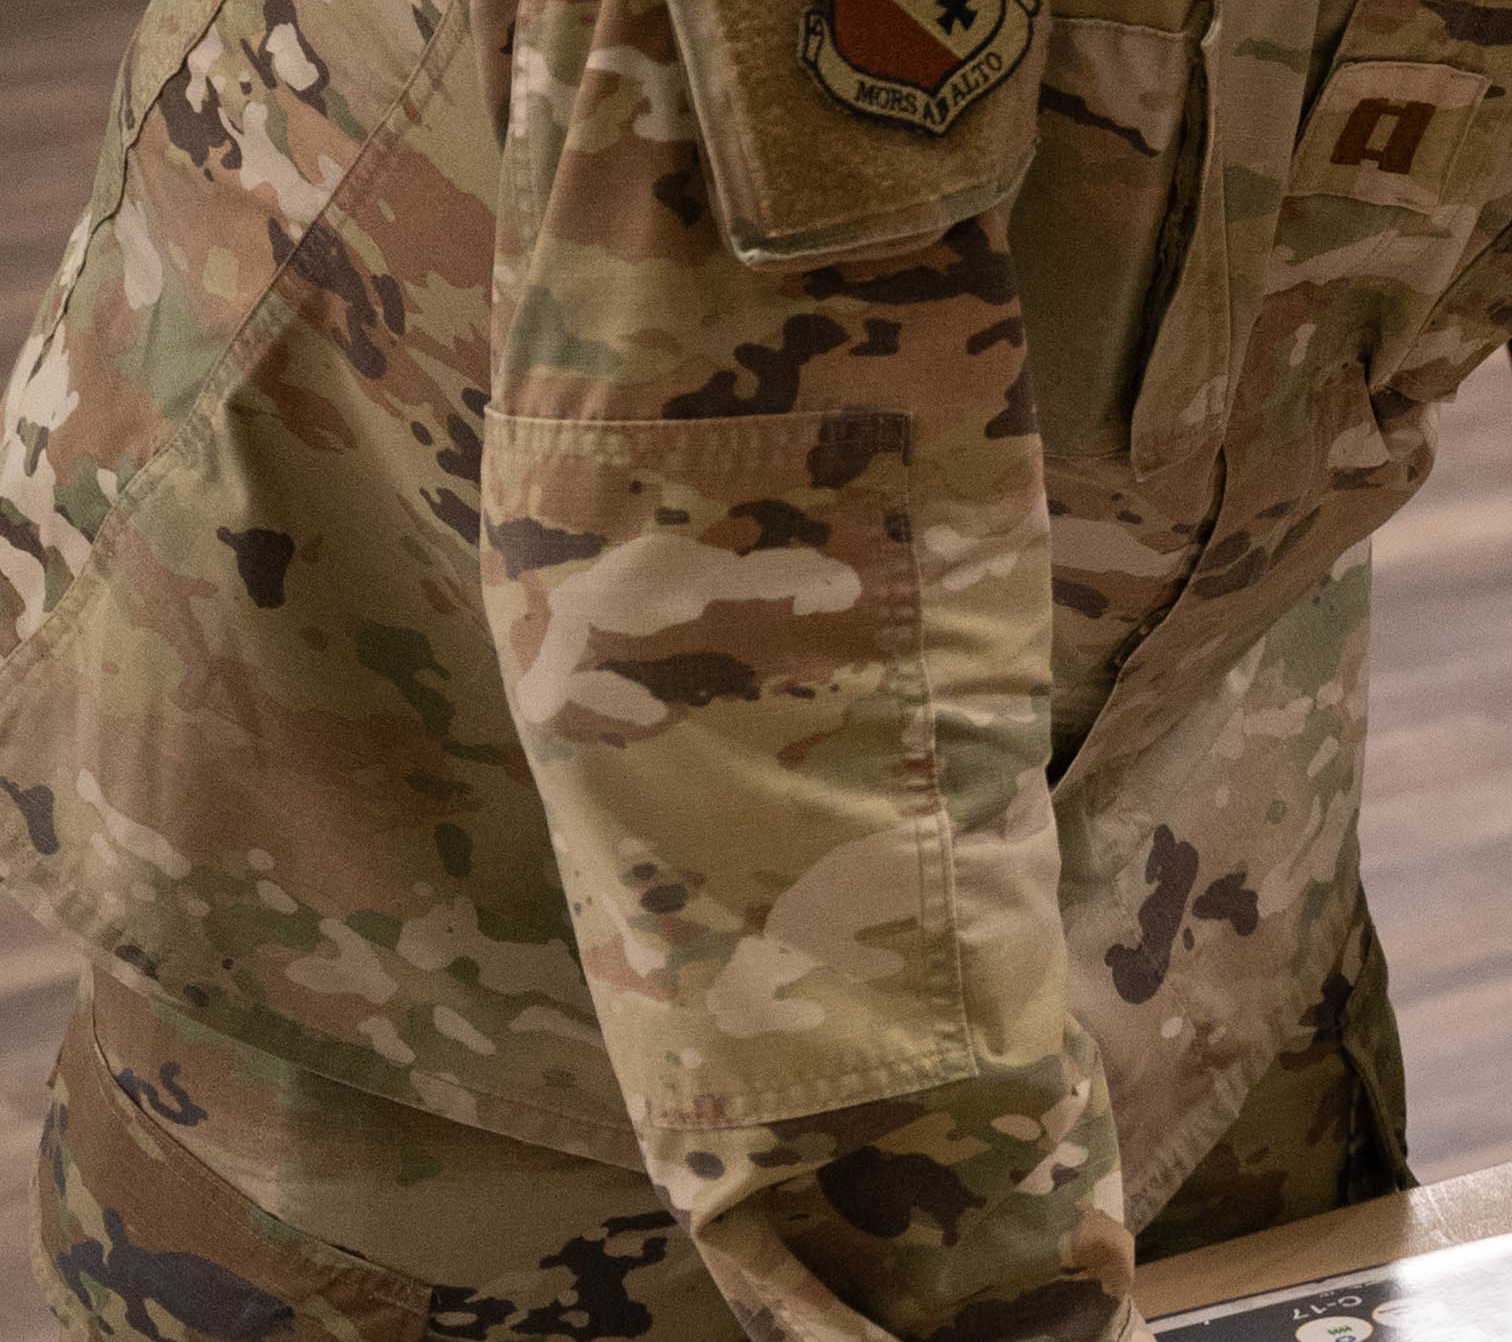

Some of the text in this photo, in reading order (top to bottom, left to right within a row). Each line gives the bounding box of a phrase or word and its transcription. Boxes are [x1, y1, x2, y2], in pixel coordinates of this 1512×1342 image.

[855, 80, 917, 115] MORS
[948, 53, 1002, 106] ALTO
[1290, 1294, 1364, 1321] C-17
